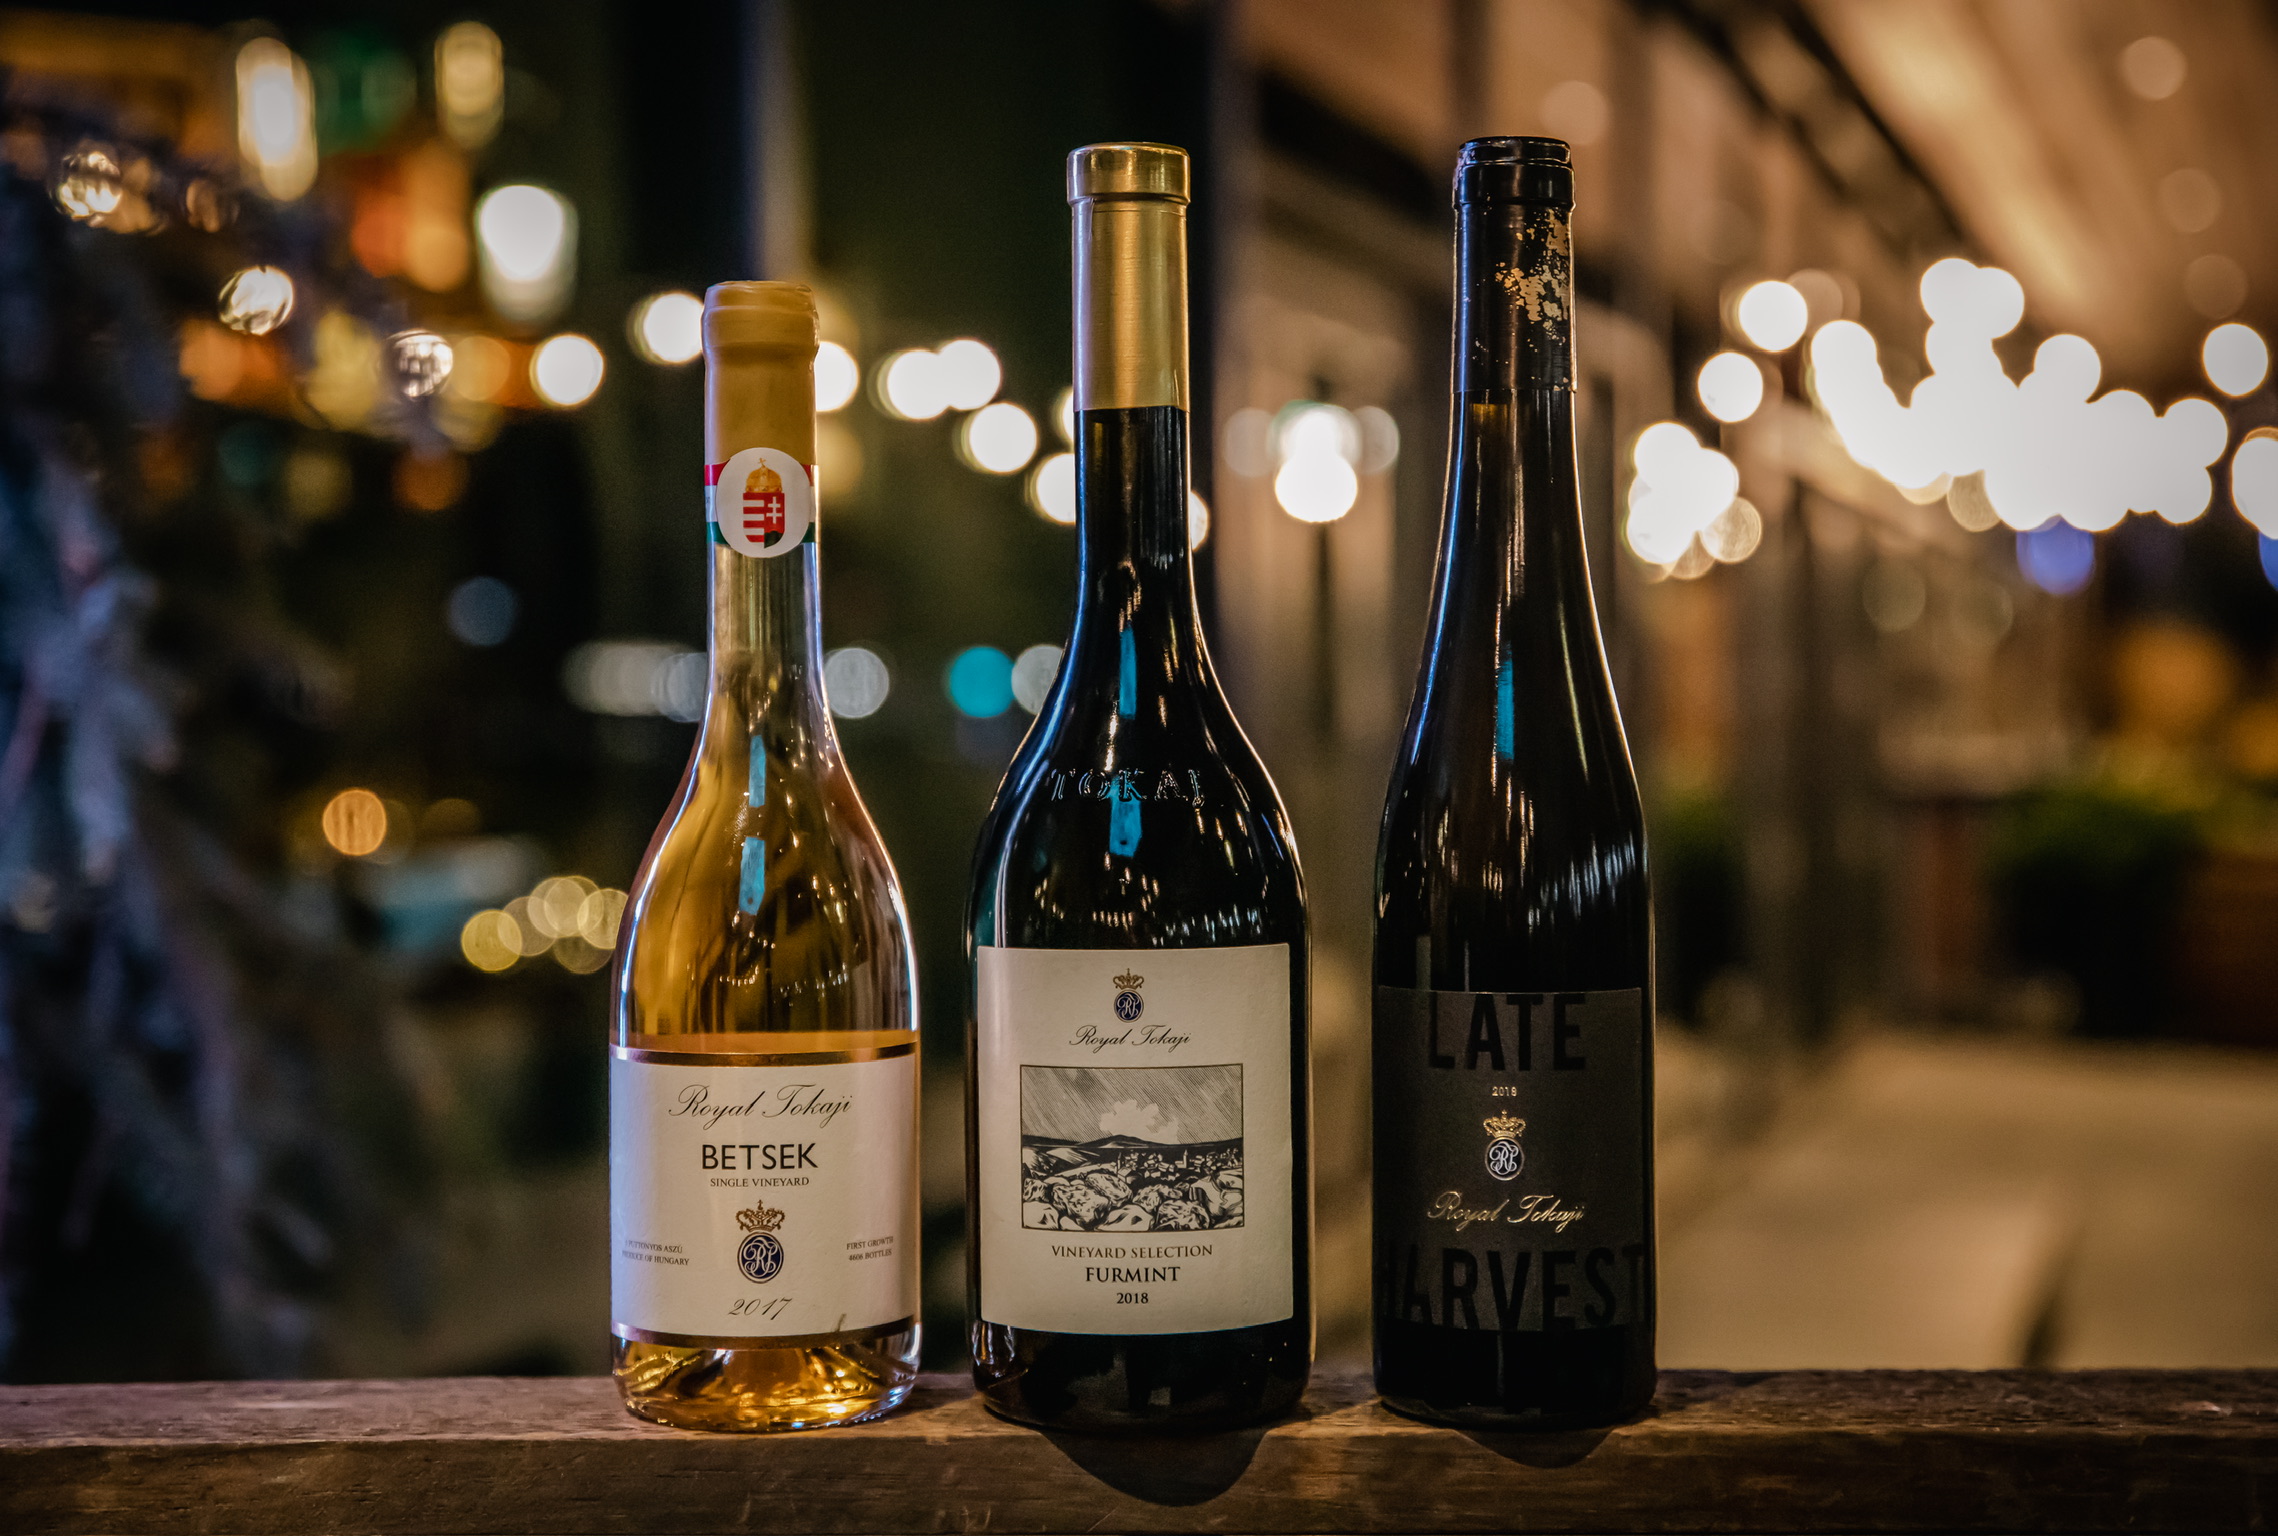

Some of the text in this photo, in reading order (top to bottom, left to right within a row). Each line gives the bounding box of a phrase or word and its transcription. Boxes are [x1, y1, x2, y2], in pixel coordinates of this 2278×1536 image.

[1069, 1024, 1192, 1054] Royal Tokaji
[1429, 992, 1586, 1071] LATE
[1491, 1085, 1518, 1097] 2018
[668, 1082, 854, 1130] Royal Tokaji
[702, 1142, 818, 1171] BETSEK
[710, 1176, 810, 1188] SINGLE VINEYARD
[1427, 1190, 1586, 1234] Royal Tokaji
[664, 1244, 683, 1254] ASZÚ
[846, 1236, 894, 1250] FIRST GROWTH
[864, 1248, 892, 1260] BOTTLES
[1052, 1244, 1214, 1259] VINEYARD SELECTION
[644, 1254, 653, 1263] OF
[654, 1256, 690, 1266] HUNGARY
[1085, 1266, 1181, 1283] FURMINT
[1116, 1292, 1149, 1305] 2018
[728, 1297, 793, 1321] 2017
